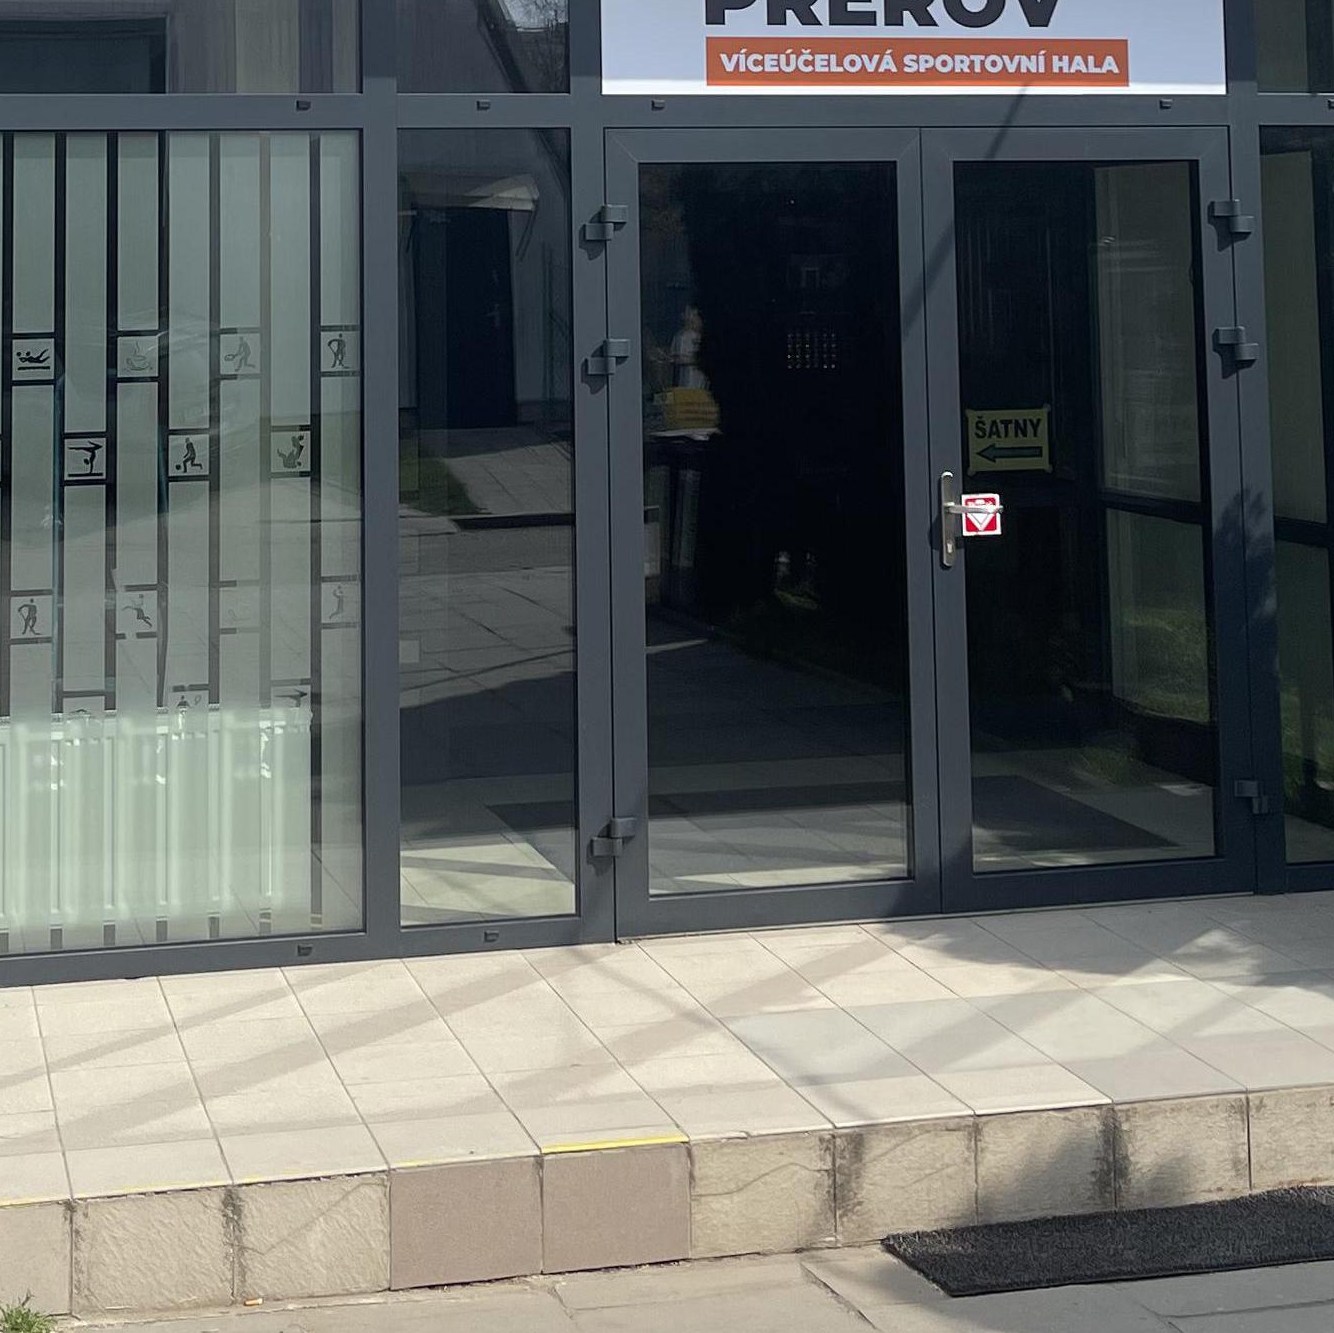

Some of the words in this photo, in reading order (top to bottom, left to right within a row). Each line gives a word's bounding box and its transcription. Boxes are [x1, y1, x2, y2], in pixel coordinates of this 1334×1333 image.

[720, 49, 898, 73] VÍCEÚČELOVÁ
[903, 50, 1047, 73] SPORTOVNÍ
[1052, 55, 1120, 73] HALA
[974, 415, 1041, 438] ŠATNY
